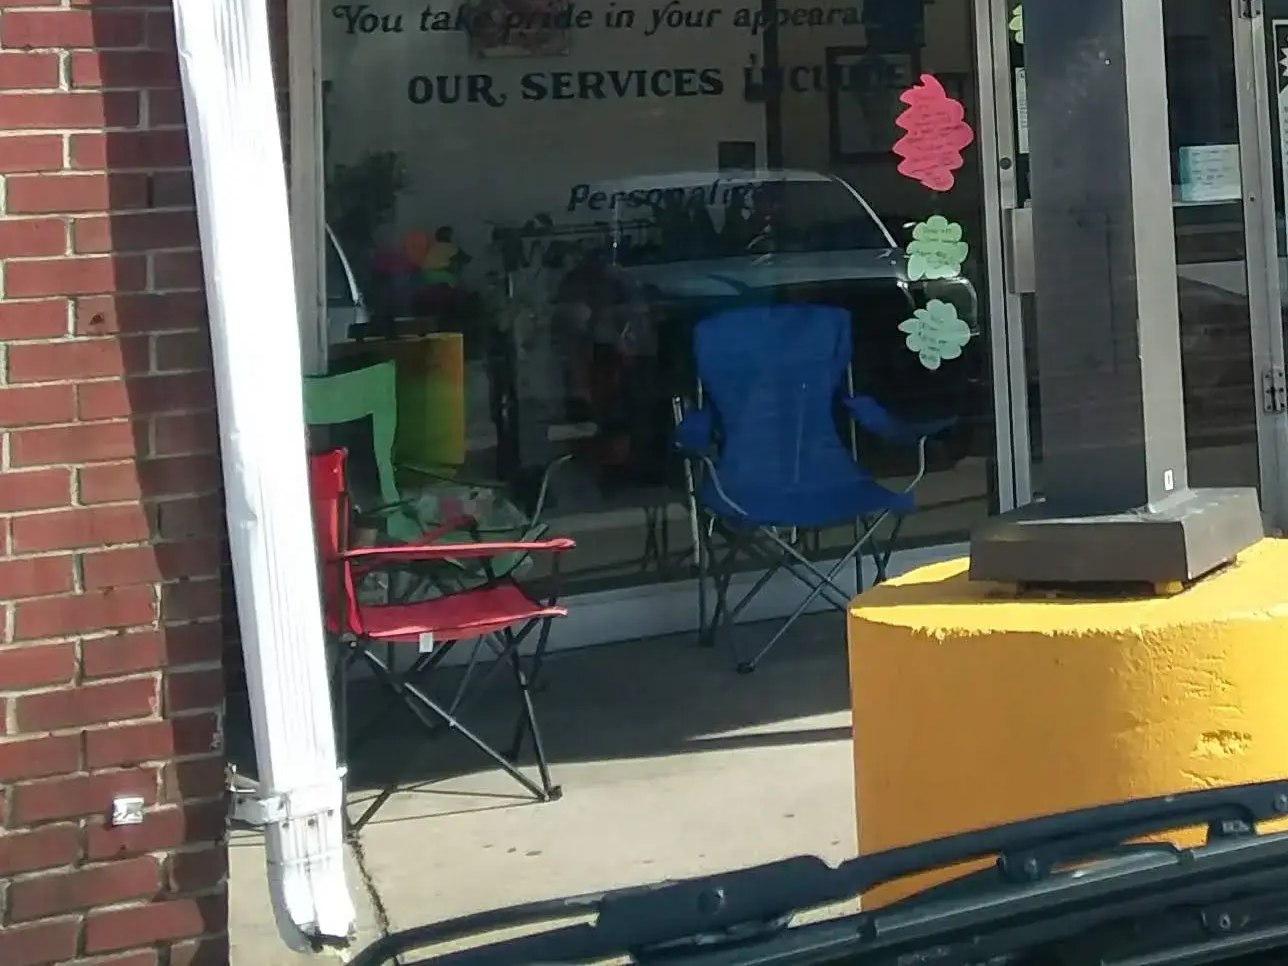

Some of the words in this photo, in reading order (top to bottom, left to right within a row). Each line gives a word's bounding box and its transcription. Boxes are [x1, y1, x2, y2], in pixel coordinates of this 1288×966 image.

[331, 4, 405, 35] You
[419, 4, 496, 38] take
[502, 1, 594, 42] pride
[604, 1, 636, 29] in
[643, 0, 722, 37] your
[407, 74, 508, 108] OUR
[519, 66, 725, 102] SERVICES
